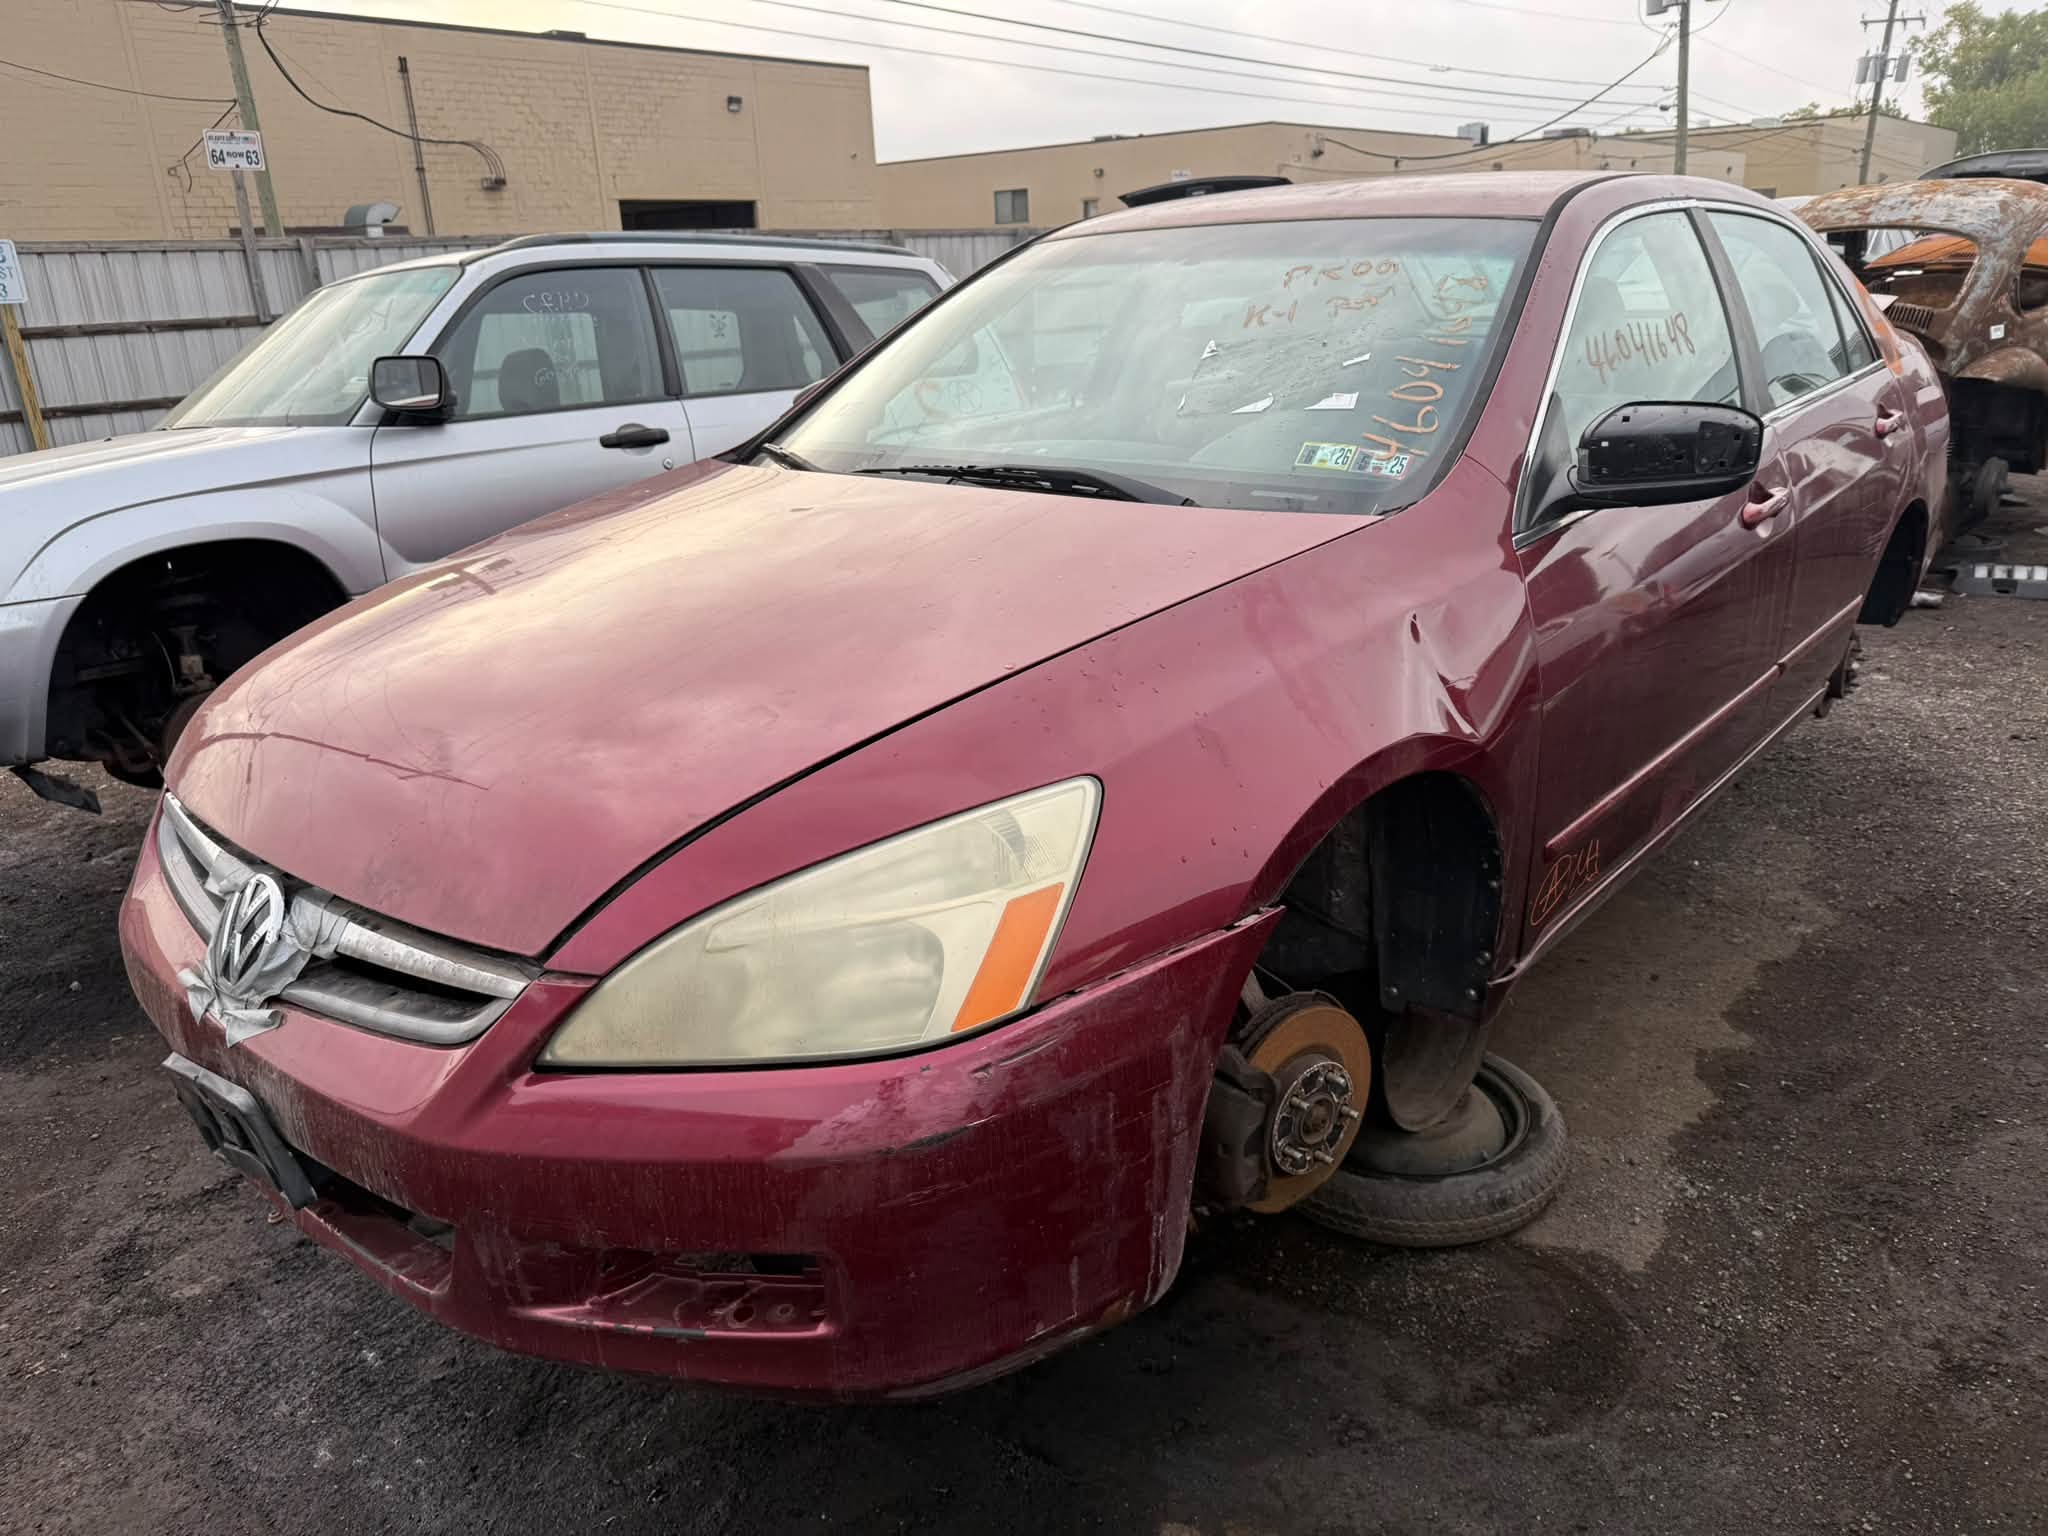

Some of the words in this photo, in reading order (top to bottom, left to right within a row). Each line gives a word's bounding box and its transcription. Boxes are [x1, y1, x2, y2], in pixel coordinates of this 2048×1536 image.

[211, 149, 225, 165] 64
[245, 150, 260, 165] 63
[1585, 310, 1696, 385] 46041648
[1334, 447, 1352, 466] 26
[1389, 455, 1408, 475] 25
